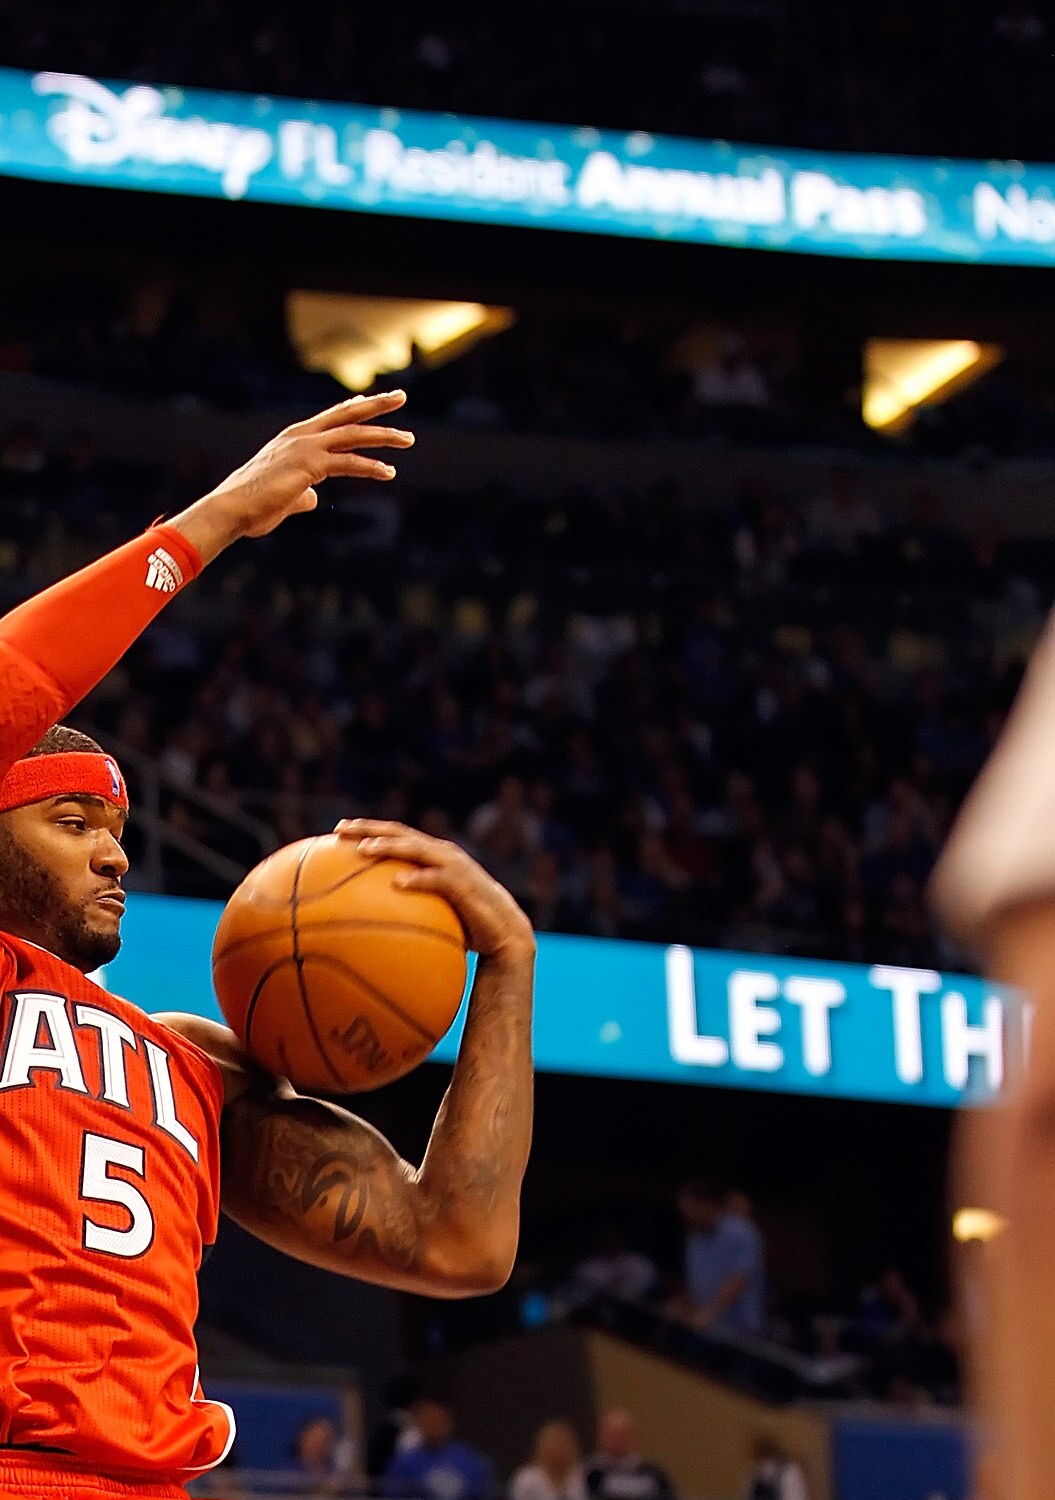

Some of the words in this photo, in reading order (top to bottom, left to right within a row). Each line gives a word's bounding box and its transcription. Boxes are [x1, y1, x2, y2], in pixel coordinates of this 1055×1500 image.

[577, 151, 785, 226] Annual
[789, 169, 927, 237] Pass
[665, 944, 846, 1076] LET
[80, 1129, 155, 1260] 5
